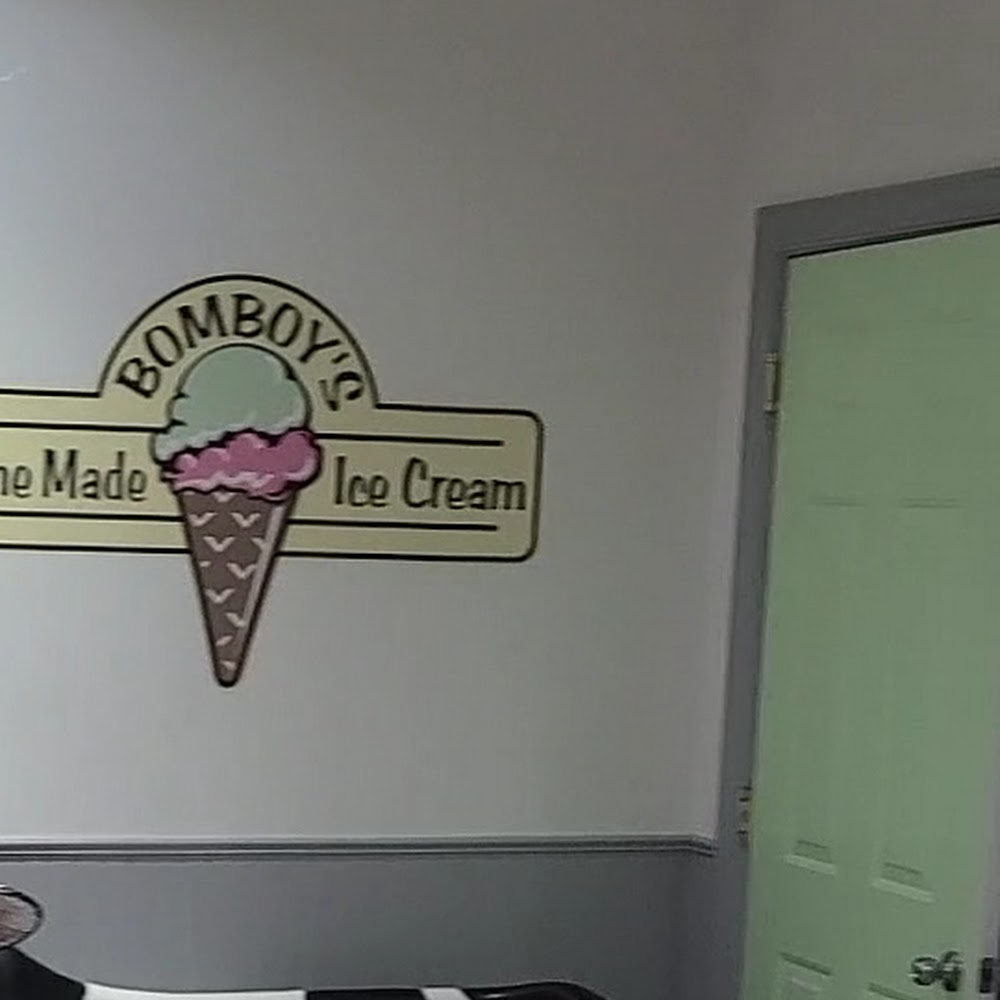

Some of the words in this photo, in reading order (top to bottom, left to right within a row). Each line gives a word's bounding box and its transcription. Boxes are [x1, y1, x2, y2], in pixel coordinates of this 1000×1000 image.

[116, 293, 364, 412] BOMBOY'S
[42, 448, 148, 501] Made
[334, 456, 389, 507] Ice
[403, 458, 527, 511] Cream
